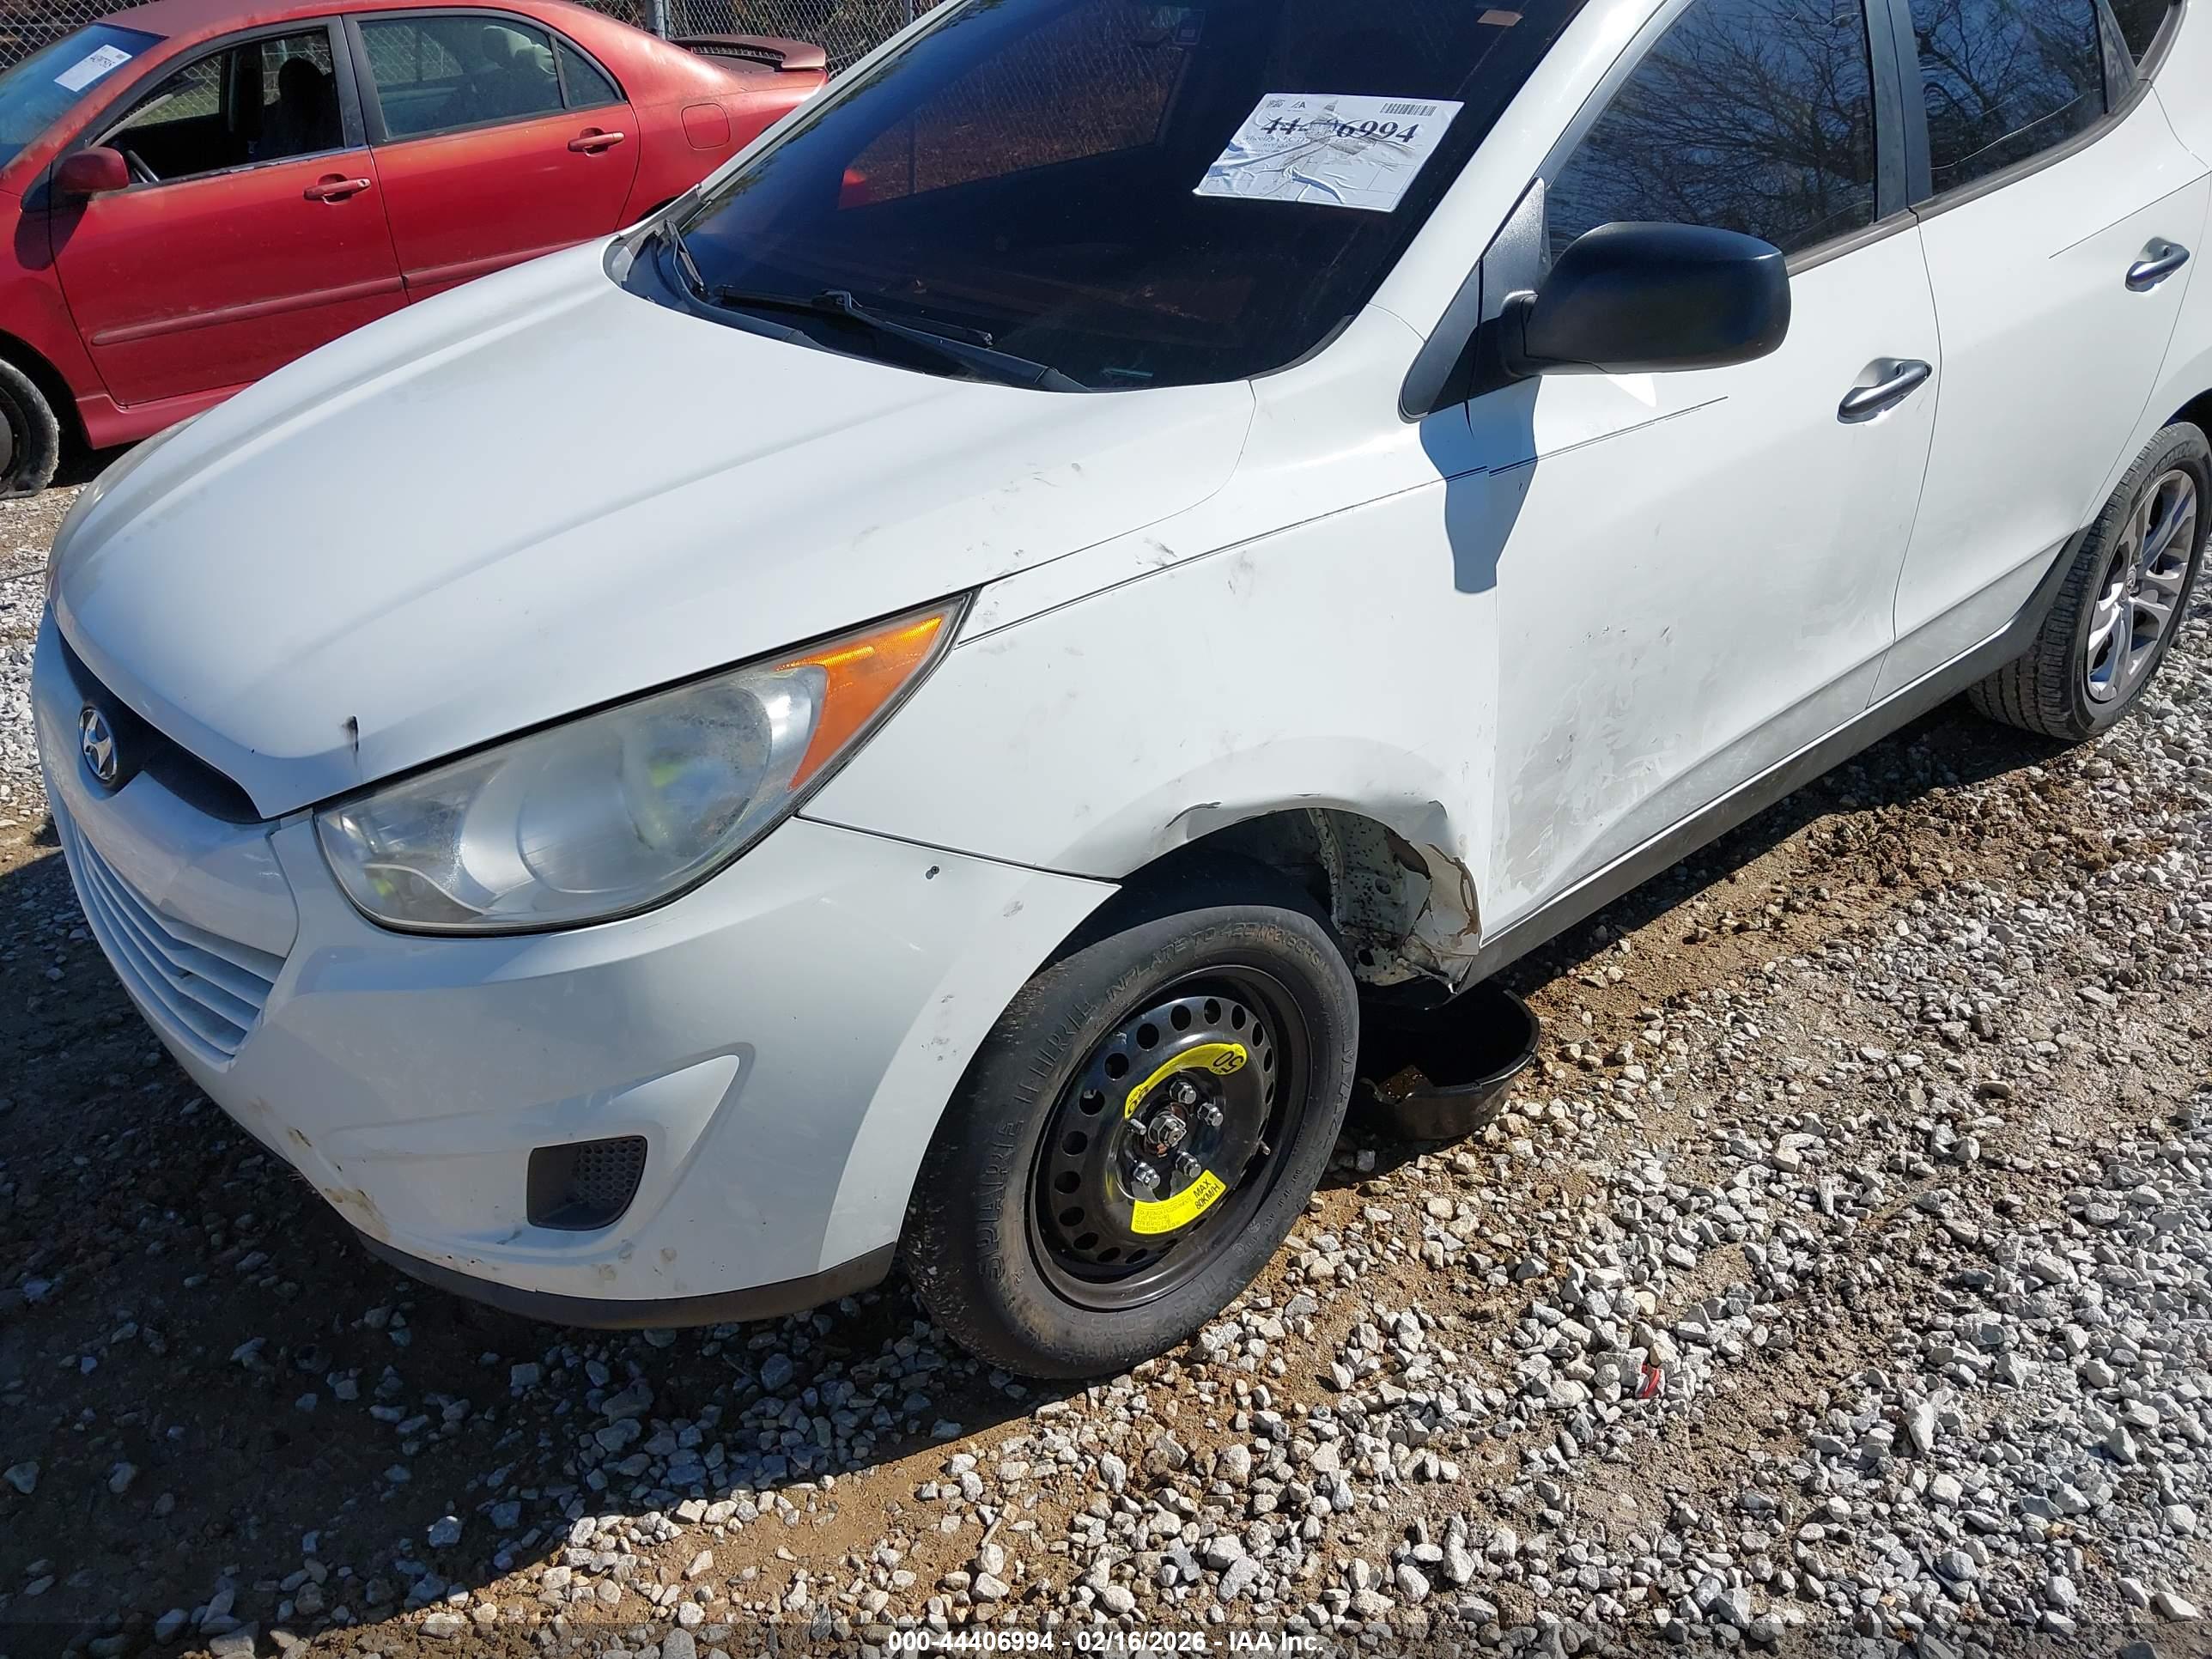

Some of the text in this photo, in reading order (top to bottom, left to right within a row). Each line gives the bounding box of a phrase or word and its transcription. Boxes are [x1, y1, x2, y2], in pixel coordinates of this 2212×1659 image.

[1261, 116, 1419, 143] 446994
[1212, 1050, 1244, 1073] 50
[1193, 1178, 1212, 1199] MAX
[1194, 1182, 1220, 1210] 80KM/H
